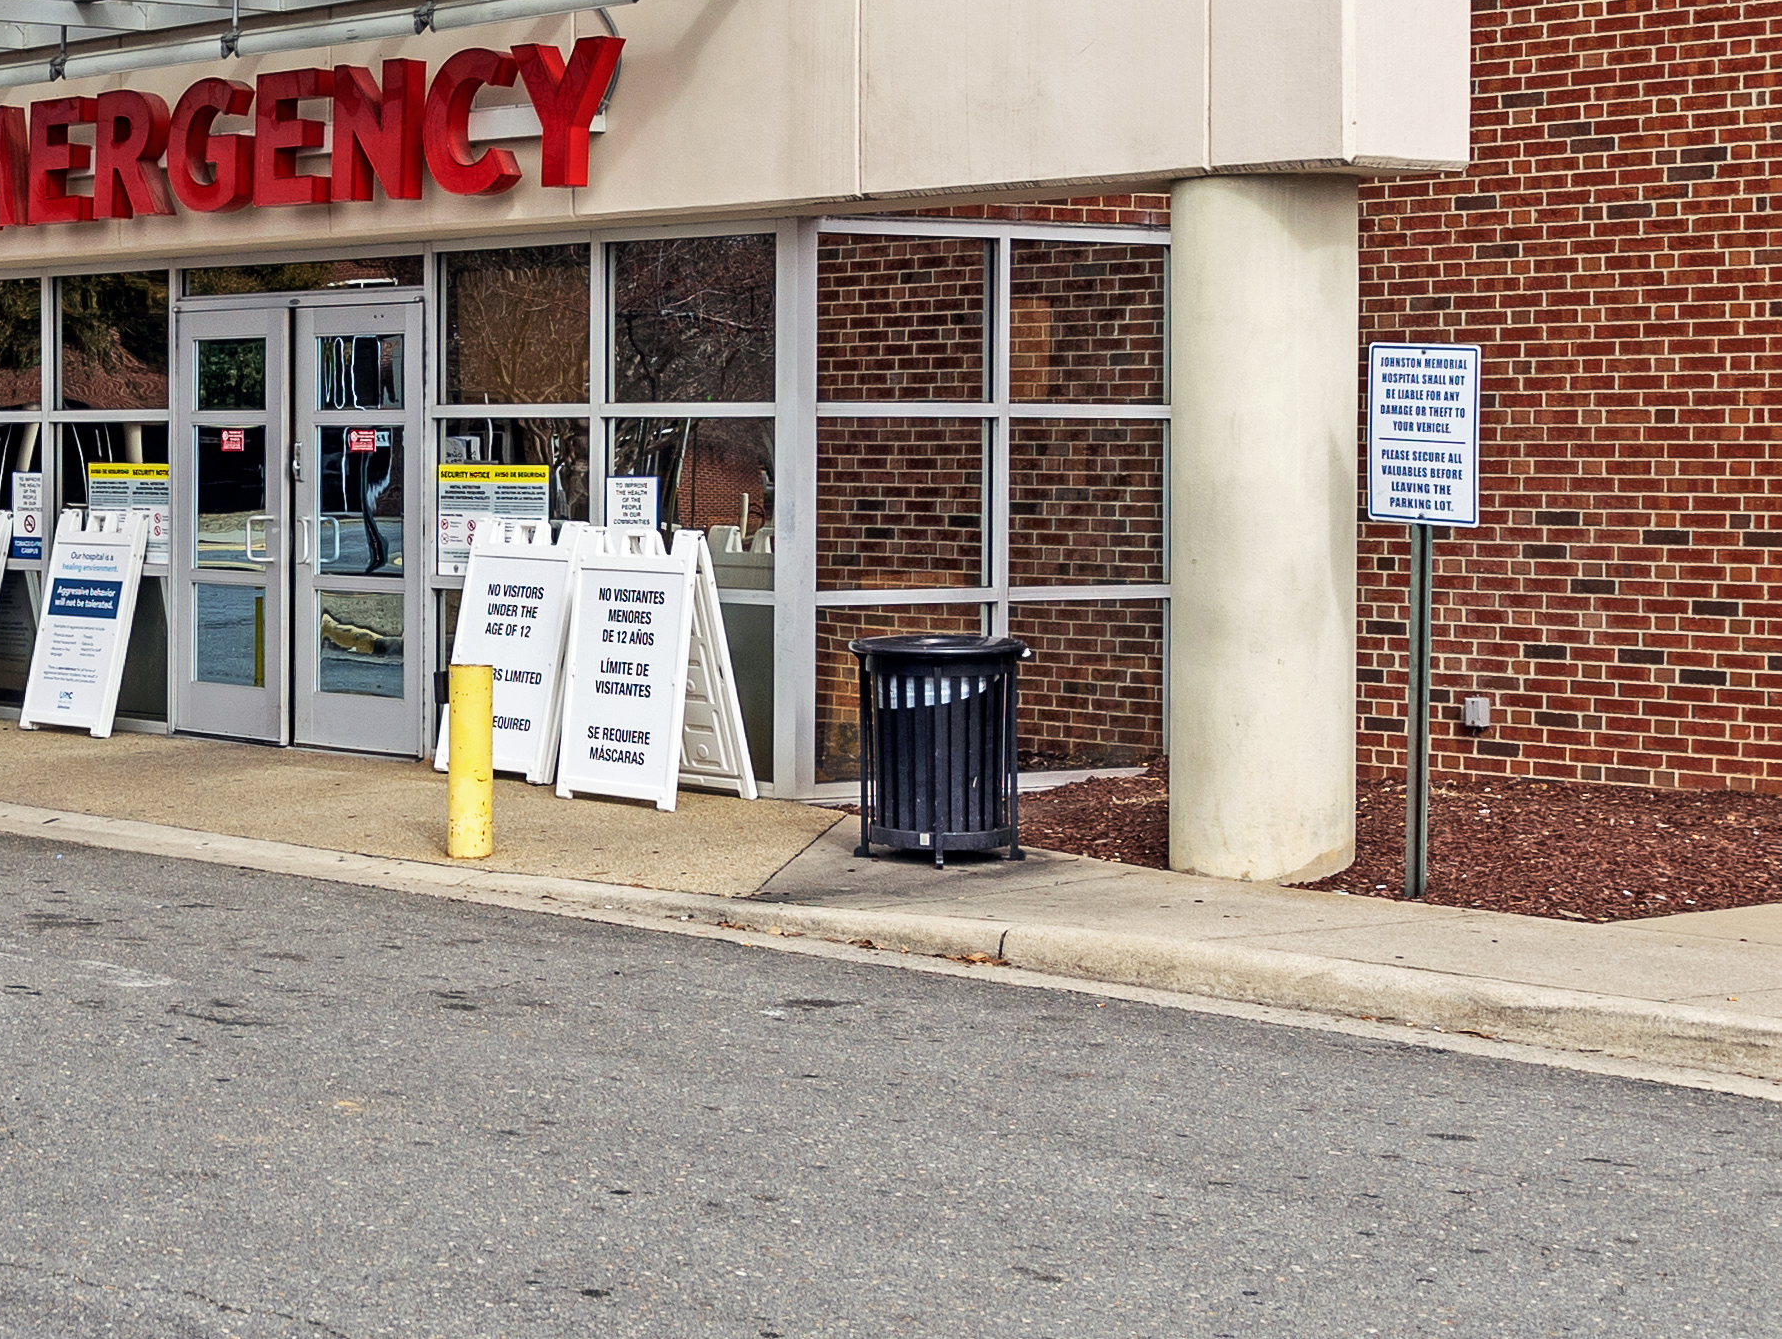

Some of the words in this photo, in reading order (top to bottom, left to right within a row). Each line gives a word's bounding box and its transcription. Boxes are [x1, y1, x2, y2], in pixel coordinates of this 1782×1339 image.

[1381, 357, 1421, 369] JOHNSTON
[1425, 358, 1467, 370] MEMORIAL
[1382, 373, 1419, 384] HOSPITAL
[1422, 374, 1446, 385] SHALL
[1449, 375, 1465, 386] NOT
[1386, 389, 1395, 399] BE
[1398, 389, 1423, 400] LIABLE
[1426, 390, 1441, 401] FOR
[1444, 391, 1459, 401] ANY
[1381, 404, 1412, 416] DAMAGE
[1416, 406, 1426, 416] OR
[1429, 407, 1452, 418] THEFT
[1455, 408, 1465, 418] TO
[1393, 421, 1414, 432] YOUR
[1417, 422, 1451, 433] VEHICLE.
[1382, 449, 1409, 461] PLEASE
[1412, 451, 1445, 463] SECURE
[1448, 453, 1462, 464] ALL
[1382, 465, 1427, 478] VALUABLES
[1430, 467, 1462, 480] BEFORE
[1391, 481, 1430, 494] LEAVING
[1433, 484, 1451, 495] THE
[1390, 497, 1431, 510] PARKING
[1435, 500, 1453, 511] LOT.
[71, 551, 82, 560] Our
[83, 552, 104, 561] hospital
[62, 563, 82, 572] healing
[57, 586, 89, 596] Aggressive
[90, 586, 116, 597] behavior
[488, 583, 501, 596] NO
[503, 584, 544, 600] VISITORS
[599, 587, 611, 601] NO
[614, 588, 665, 604] VISITANTES
[54, 598, 66, 606] will
[66, 599, 76, 607] not
[85, 600, 113, 609] tolerated.
[487, 603, 518, 617] UNDER
[521, 606, 538, 619] THE
[608, 609, 652, 625] MENORES
[485, 622, 503, 636] AGE
[505, 624, 518, 637] OF
[520, 625, 531, 638] 12
[602, 629, 614, 643] DE
[617, 630, 627, 644] 12
[629, 628, 654, 646] AÑOS
[600, 658, 633, 676] LÍMITE
[636, 663, 649, 677] DE
[505, 669, 542, 685] LIMITED
[595, 680, 651, 698] VISITANTES
[493, 716, 530, 732] EQUIRED
[588, 725, 600, 740] SE
[602, 727, 650, 745] REQUIERE
[590, 745, 645, 765] MÁSCARAS
